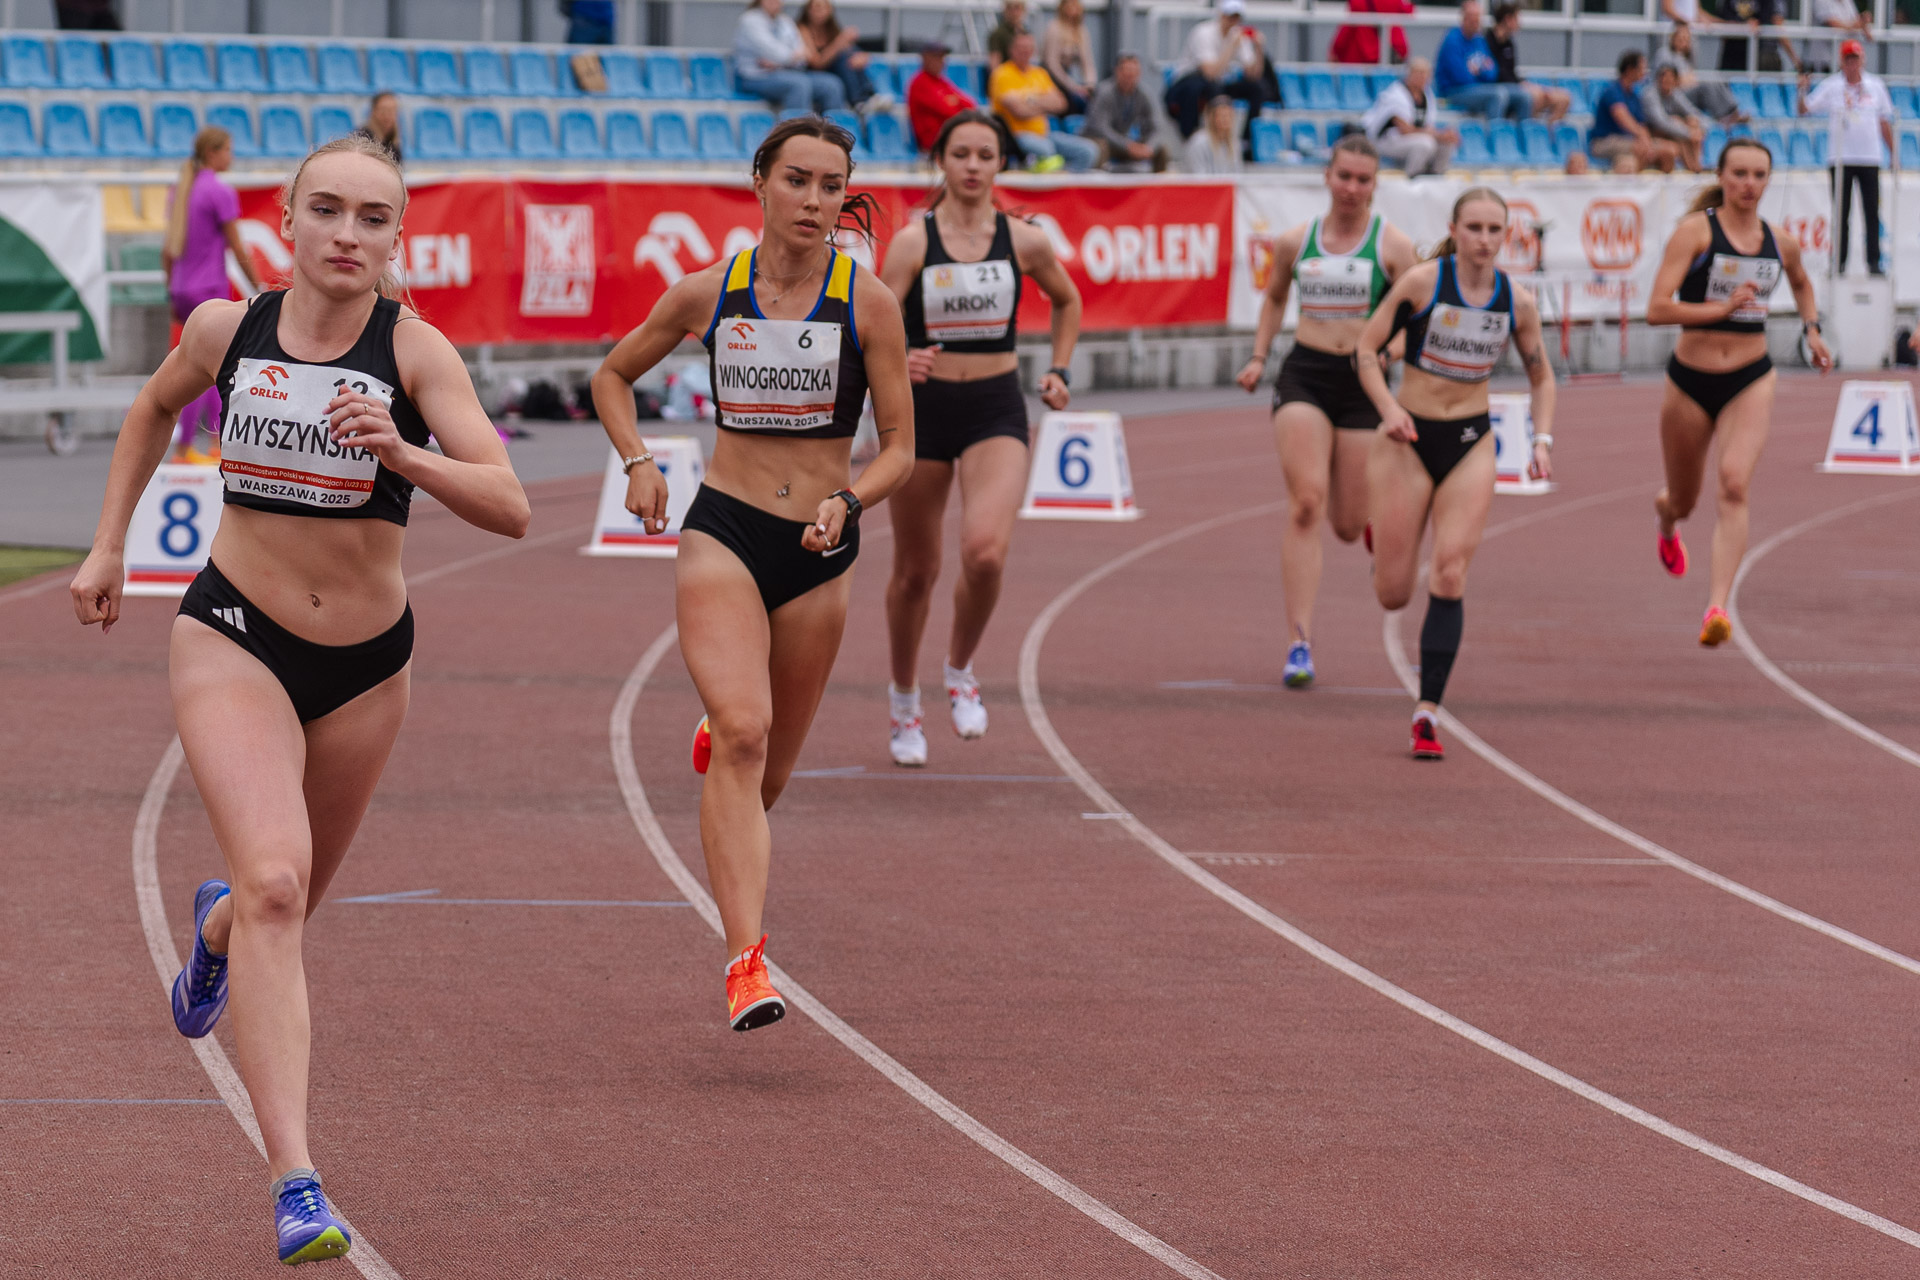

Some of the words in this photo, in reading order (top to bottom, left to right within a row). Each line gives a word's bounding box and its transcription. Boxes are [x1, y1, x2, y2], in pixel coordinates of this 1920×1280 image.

[1081, 223, 1220, 284] ORLEN
[976, 264, 1001, 282] 21
[943, 294, 998, 312] KROK
[727, 341, 757, 351] ORLEN
[798, 329, 813, 349] 6
[719, 363, 832, 391] WINOGRODZKA
[249, 386, 288, 401] ORLEN
[731, 415, 792, 426] WARSZAWA
[794, 415, 819, 427] 2025
[1851, 401, 1884, 447] 4
[224, 462, 239, 470] PZLA
[240, 464, 278, 477] Mistrzostwa
[279, 470, 298, 480] Polski
[305, 475, 344, 488] wielobojach
[1058, 436, 1092, 489] 6
[239, 478, 317, 502] WARSZAWA
[320, 493, 351, 505] 2025
[160, 491, 200, 558] 8
